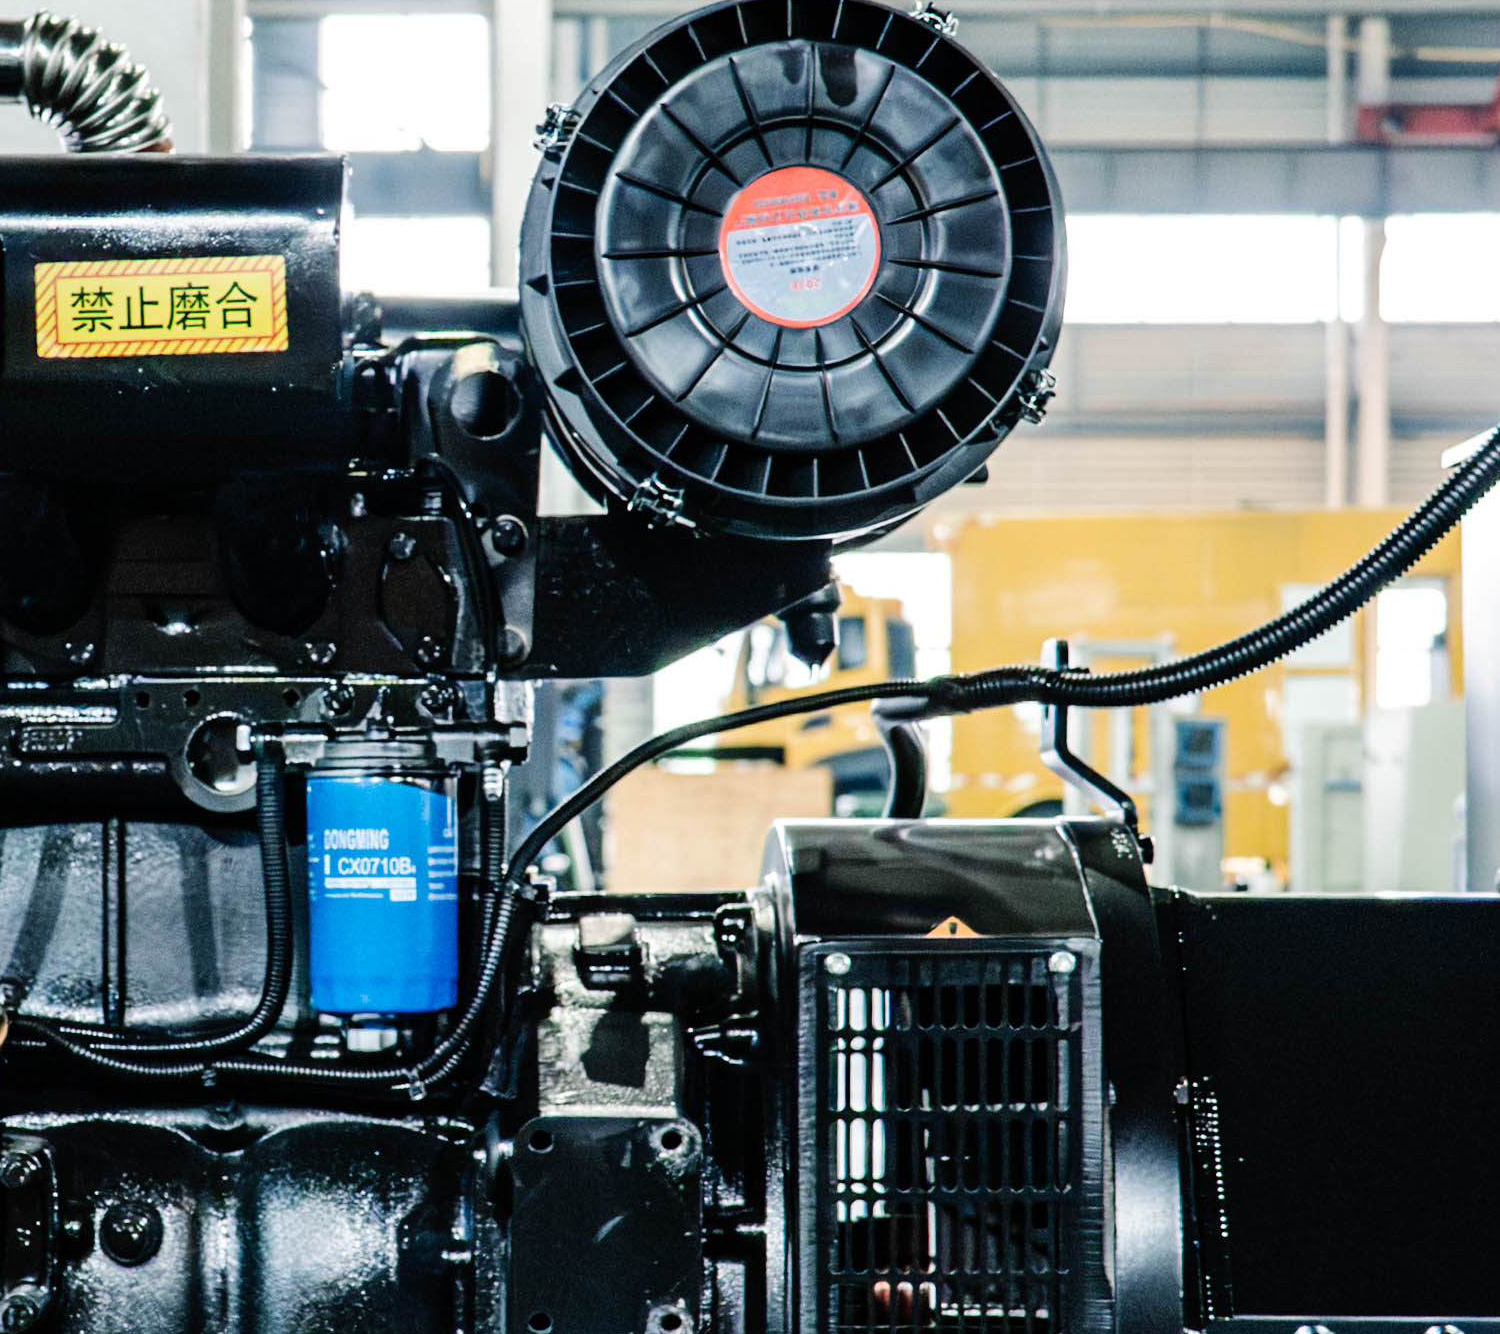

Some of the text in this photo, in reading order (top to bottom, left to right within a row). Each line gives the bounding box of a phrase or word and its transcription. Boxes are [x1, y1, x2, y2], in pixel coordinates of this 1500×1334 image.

[71, 281, 259, 334] 禁止磨合
[323, 828, 390, 851] DONGMING
